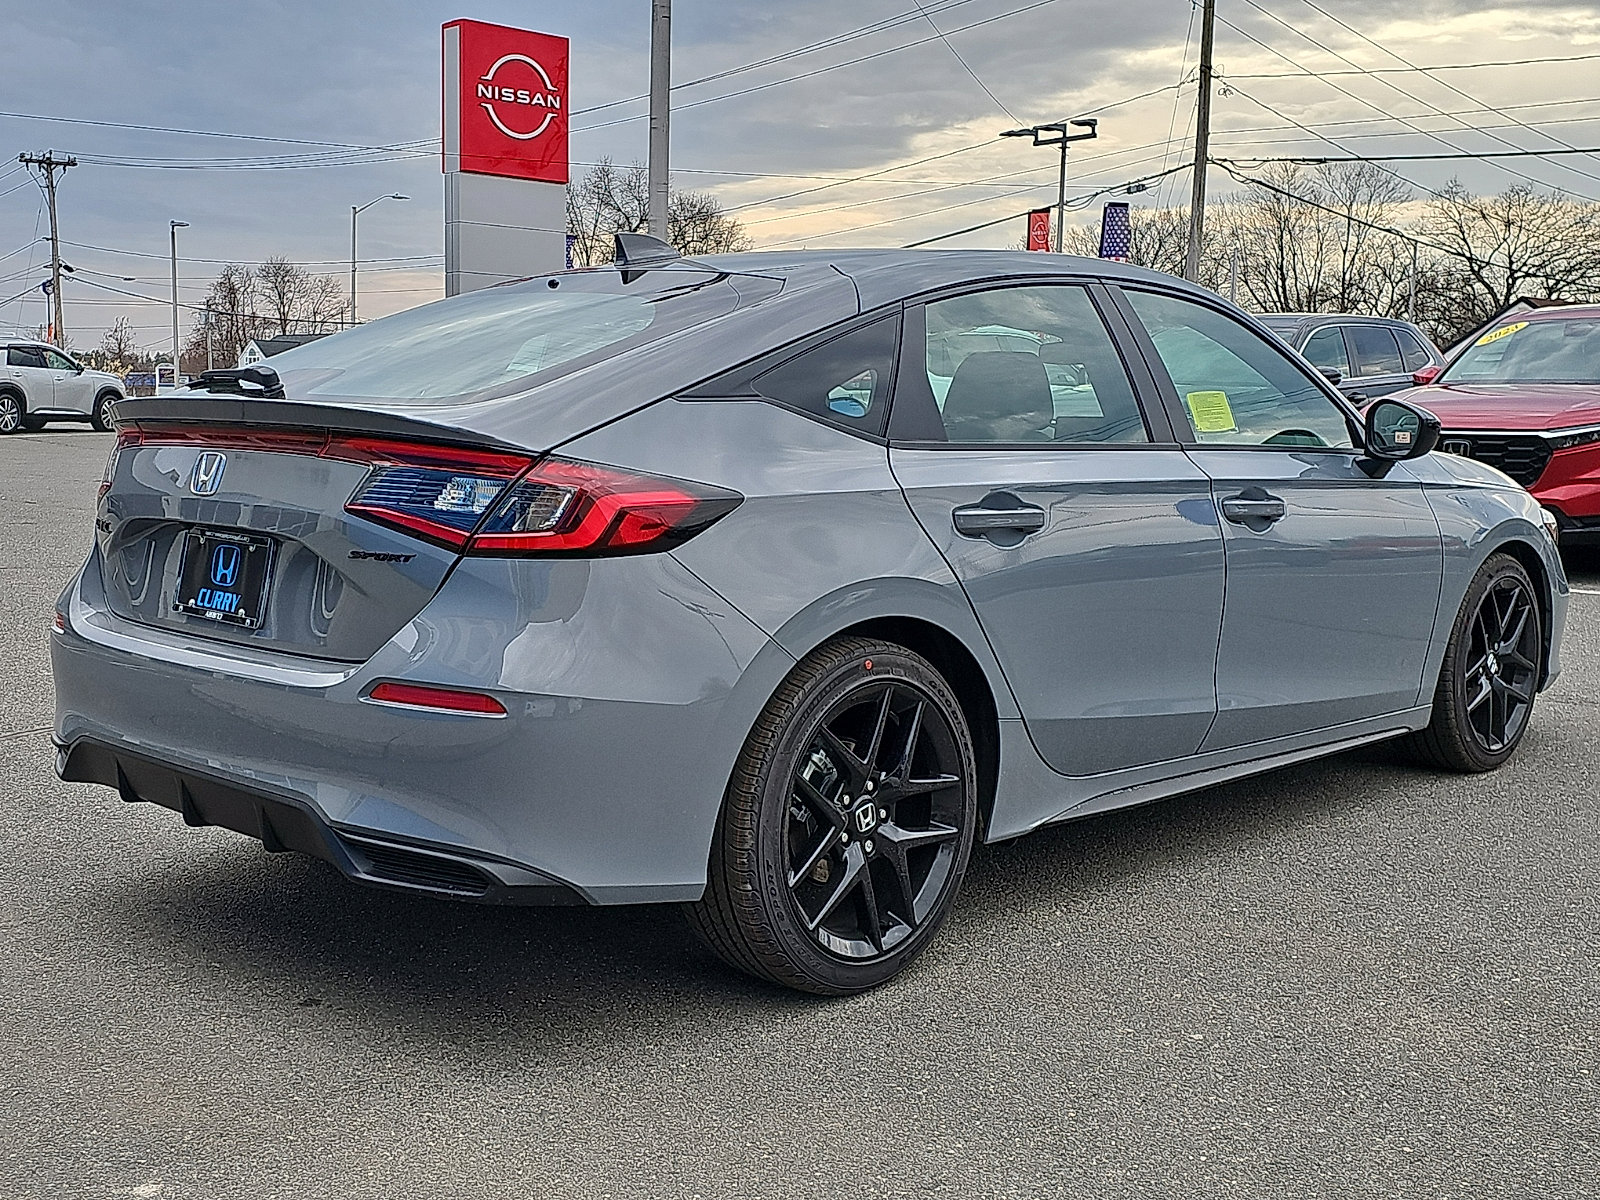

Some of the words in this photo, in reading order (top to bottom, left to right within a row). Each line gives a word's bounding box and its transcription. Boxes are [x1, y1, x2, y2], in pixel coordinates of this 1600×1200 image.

[477, 83, 561, 110] NISSAN
[347, 549, 418, 563] SPORT
[197, 588, 242, 613] CURRY
